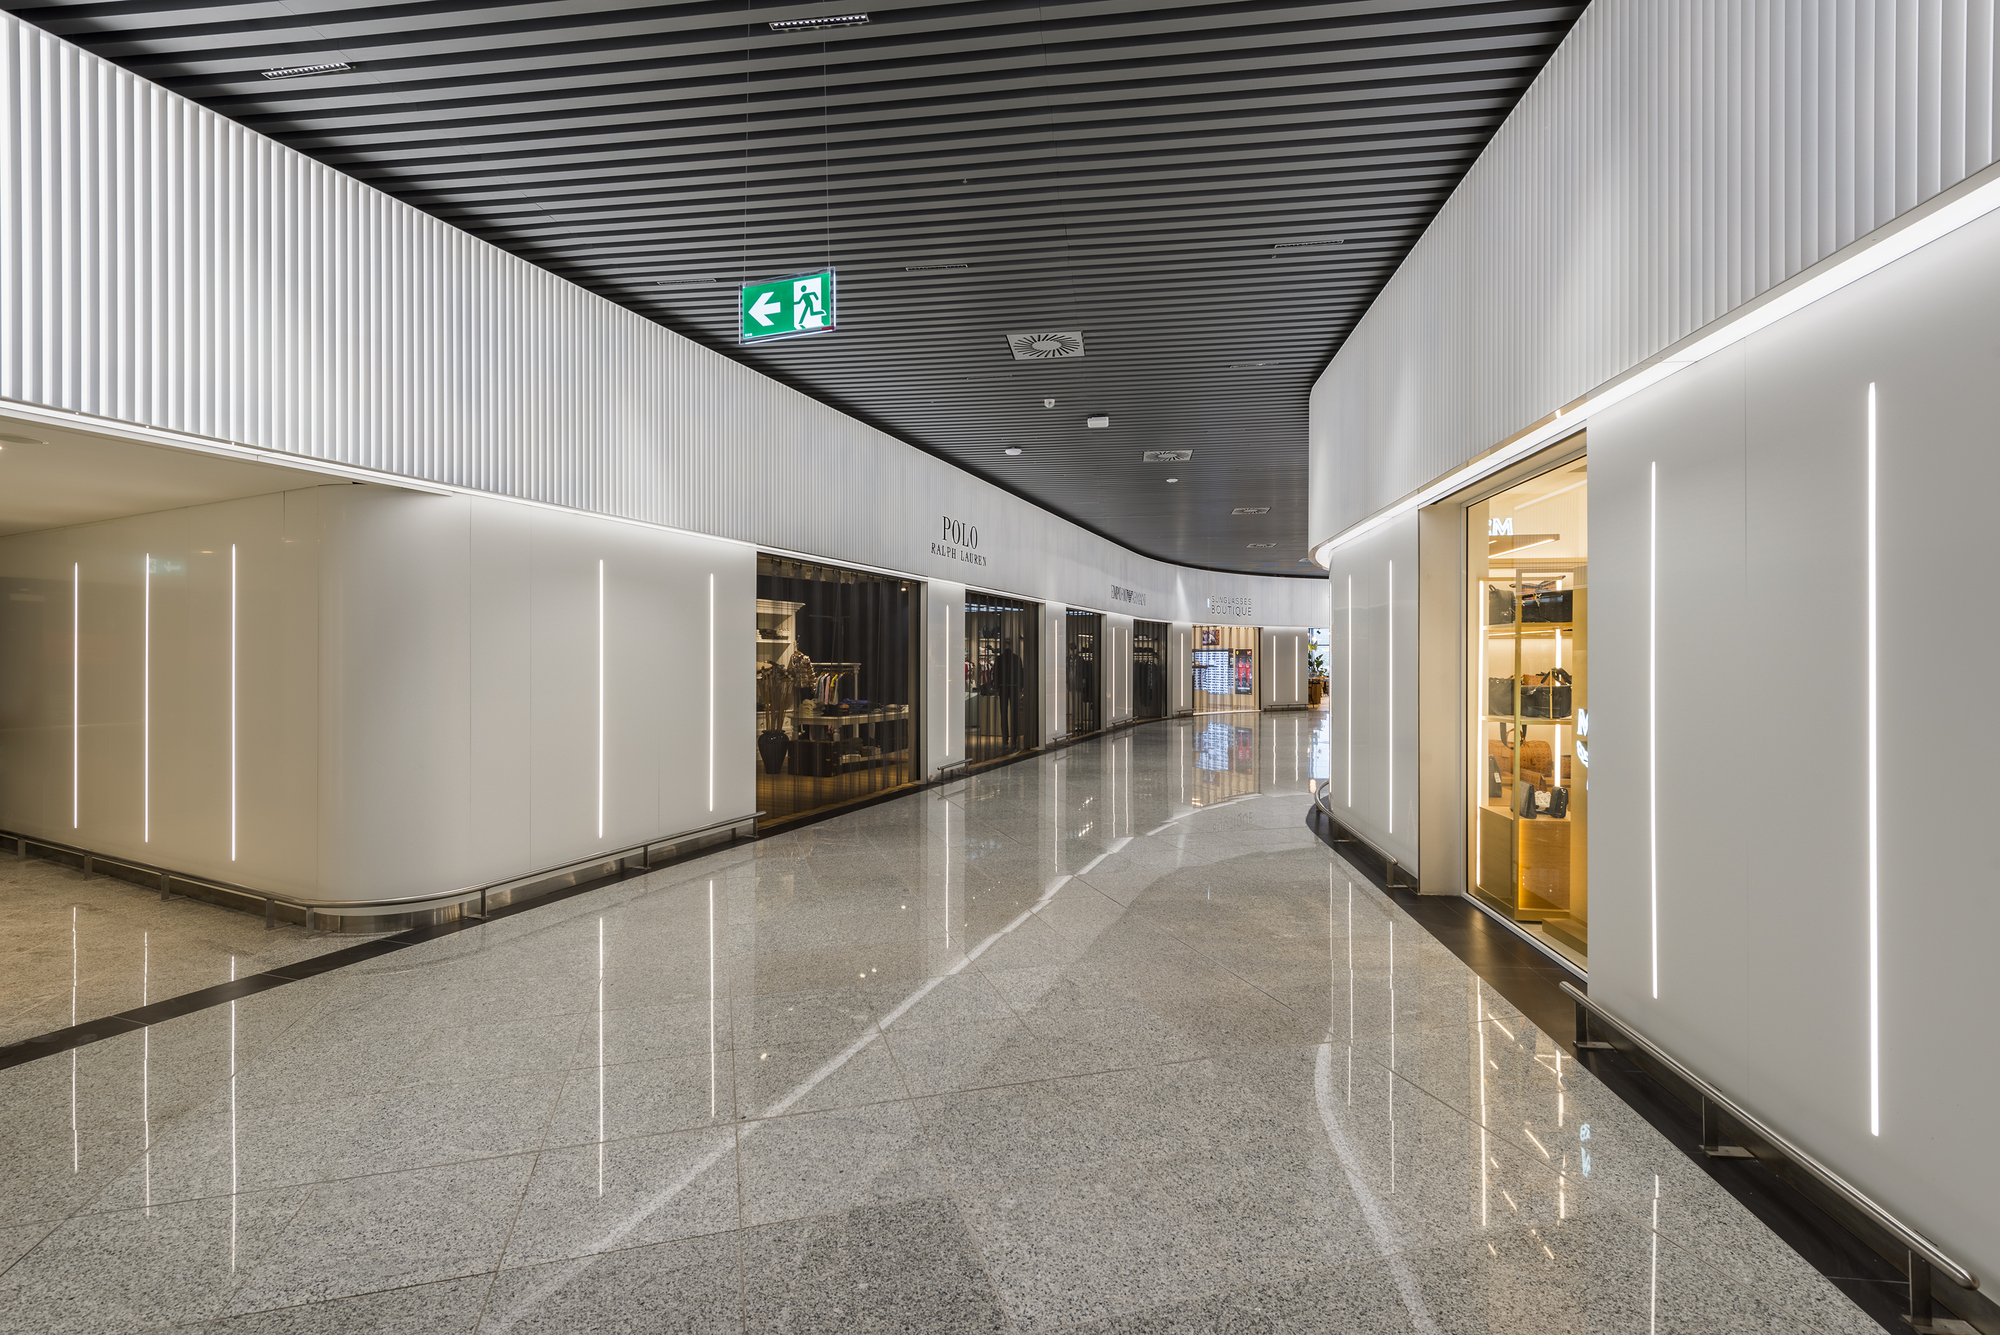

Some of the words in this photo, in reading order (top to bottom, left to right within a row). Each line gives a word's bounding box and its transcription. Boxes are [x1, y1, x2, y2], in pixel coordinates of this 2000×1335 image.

[942, 515, 978, 549] POLO
[931, 542, 957, 559] RALPH
[960, 550, 987, 566] LAUREN
[1211, 595, 1252, 605] SUNGLASSES
[1211, 604, 1252, 617] BOUTIQUE
